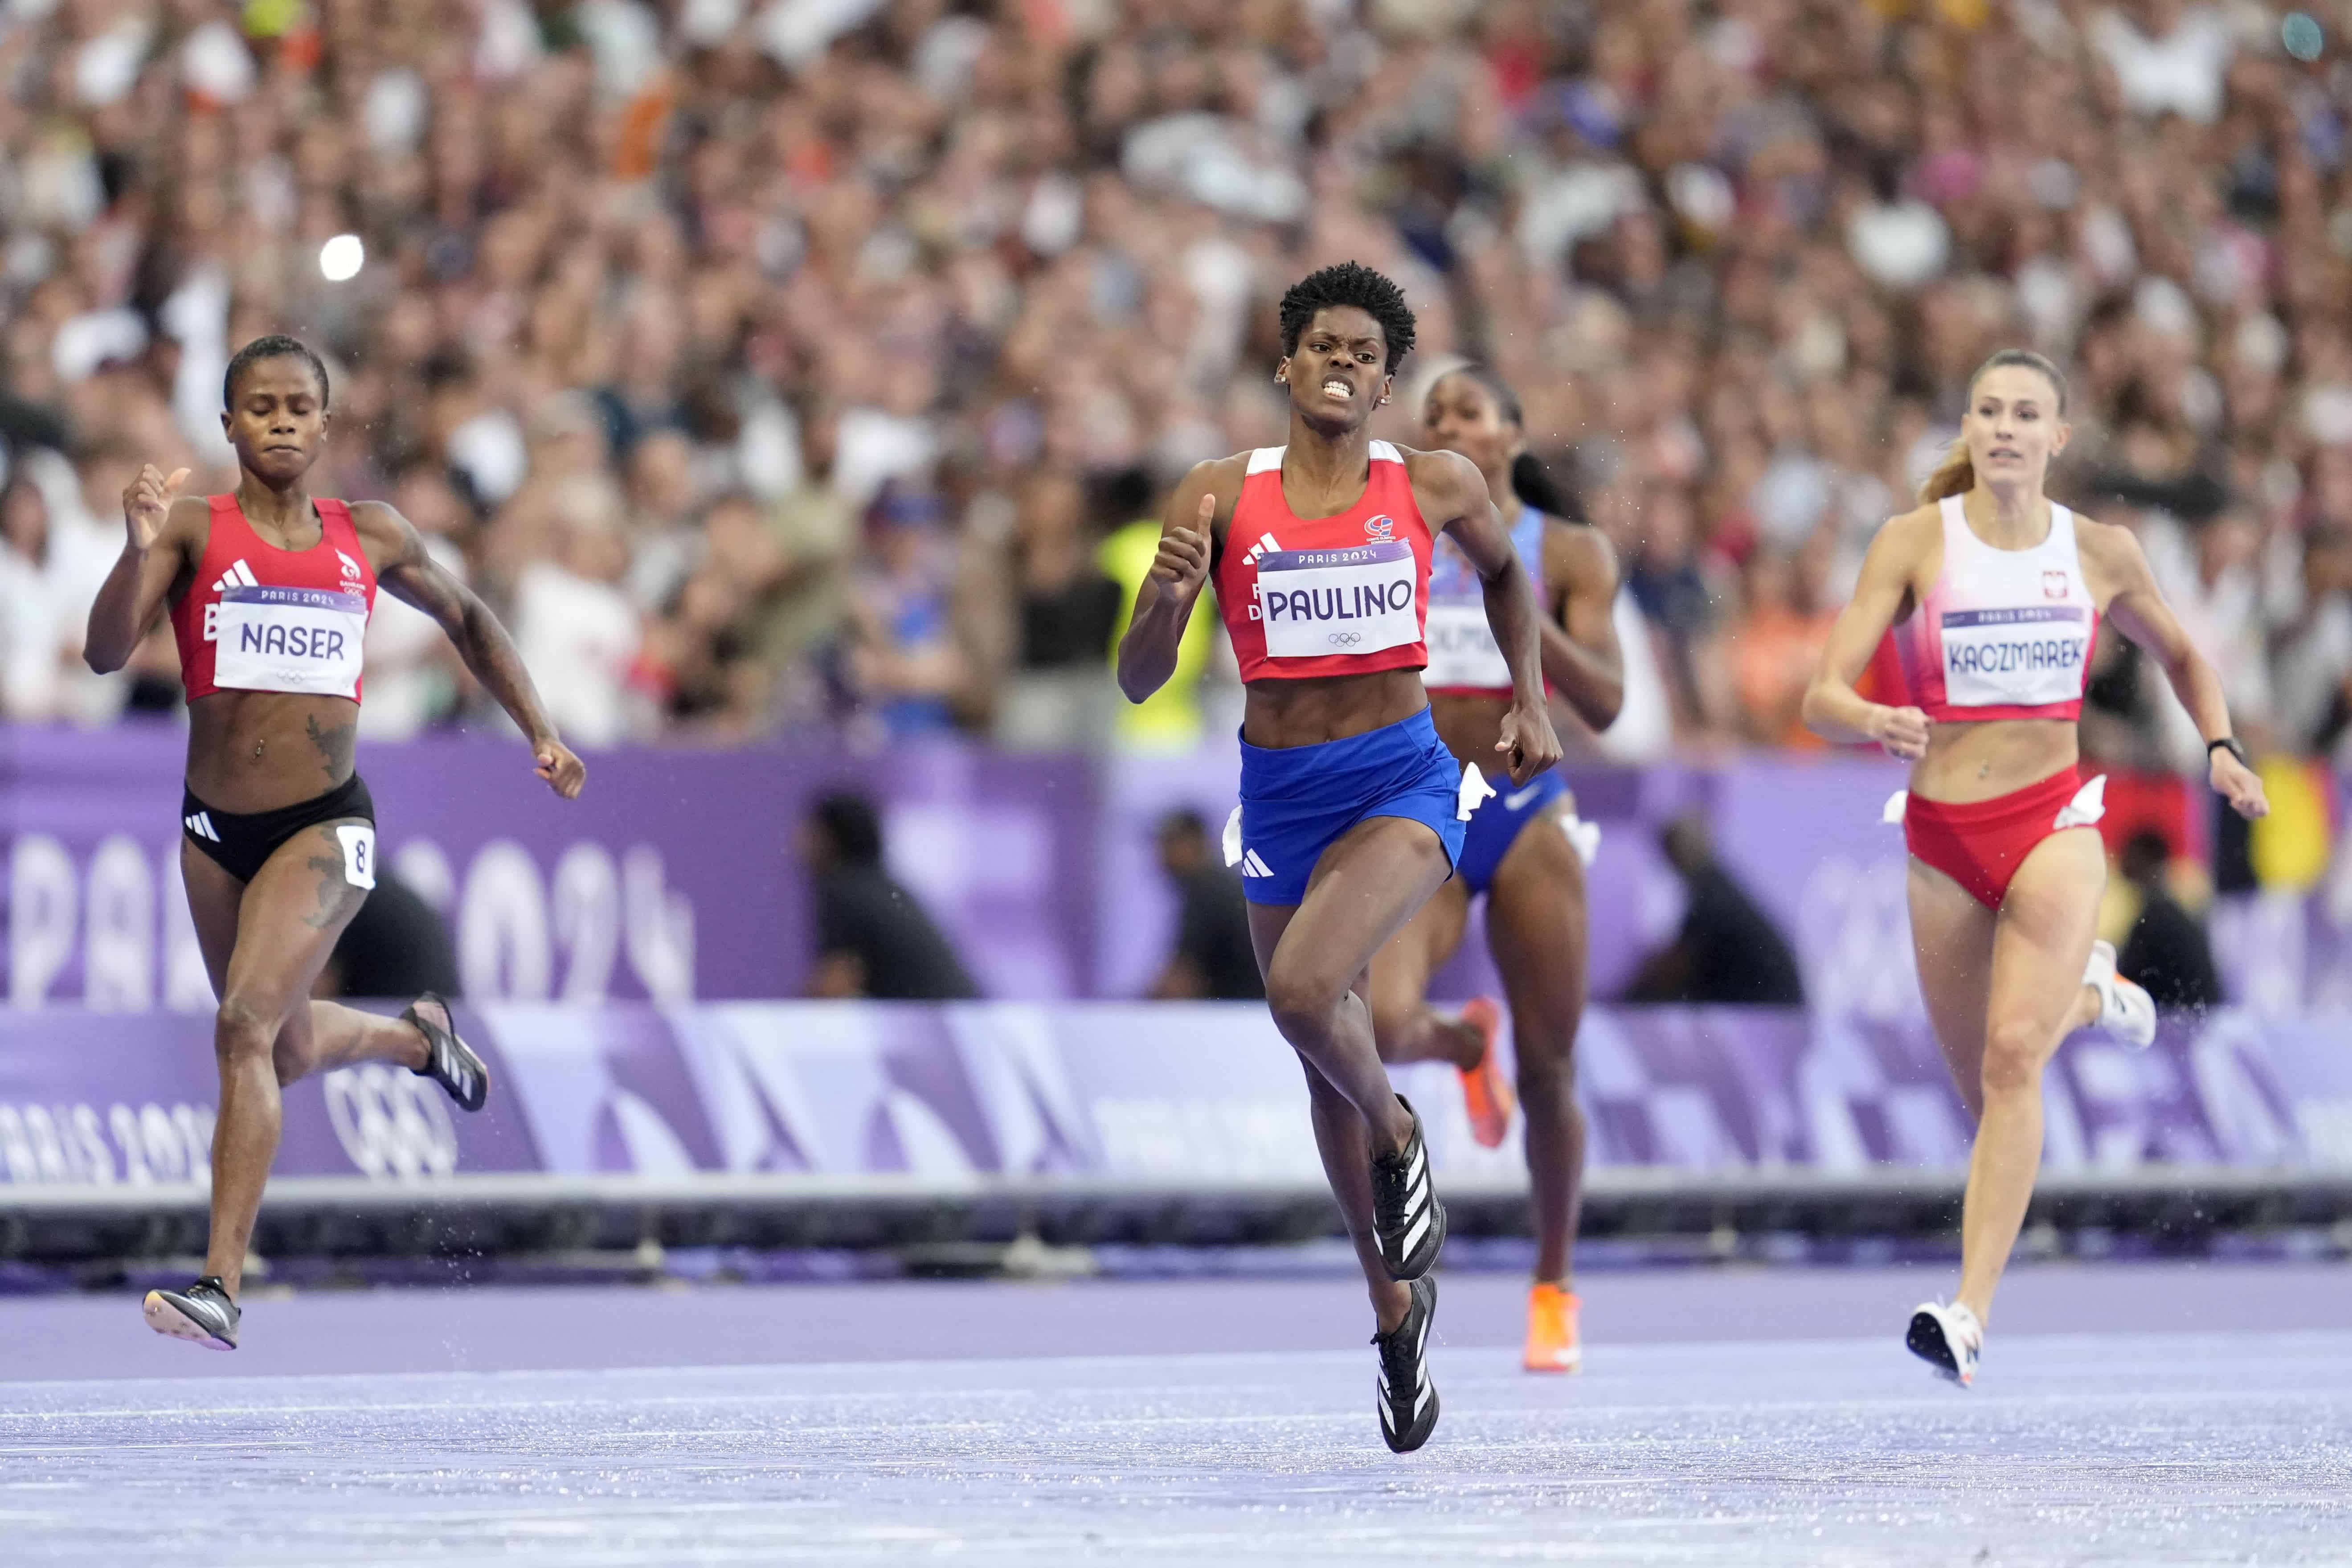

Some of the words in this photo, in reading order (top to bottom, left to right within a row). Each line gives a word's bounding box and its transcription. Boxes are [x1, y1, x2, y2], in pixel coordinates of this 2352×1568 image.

[1299, 555, 1337, 564] PARIS
[1342, 550, 1377, 561] 2024
[261, 590, 299, 602] PARIS
[303, 594, 335, 605] 2024
[1267, 579, 1412, 621] PAULINO
[241, 622, 344, 660] NASER
[1949, 639, 2084, 672] KACZMAREK
[356, 840, 366, 874] 8
